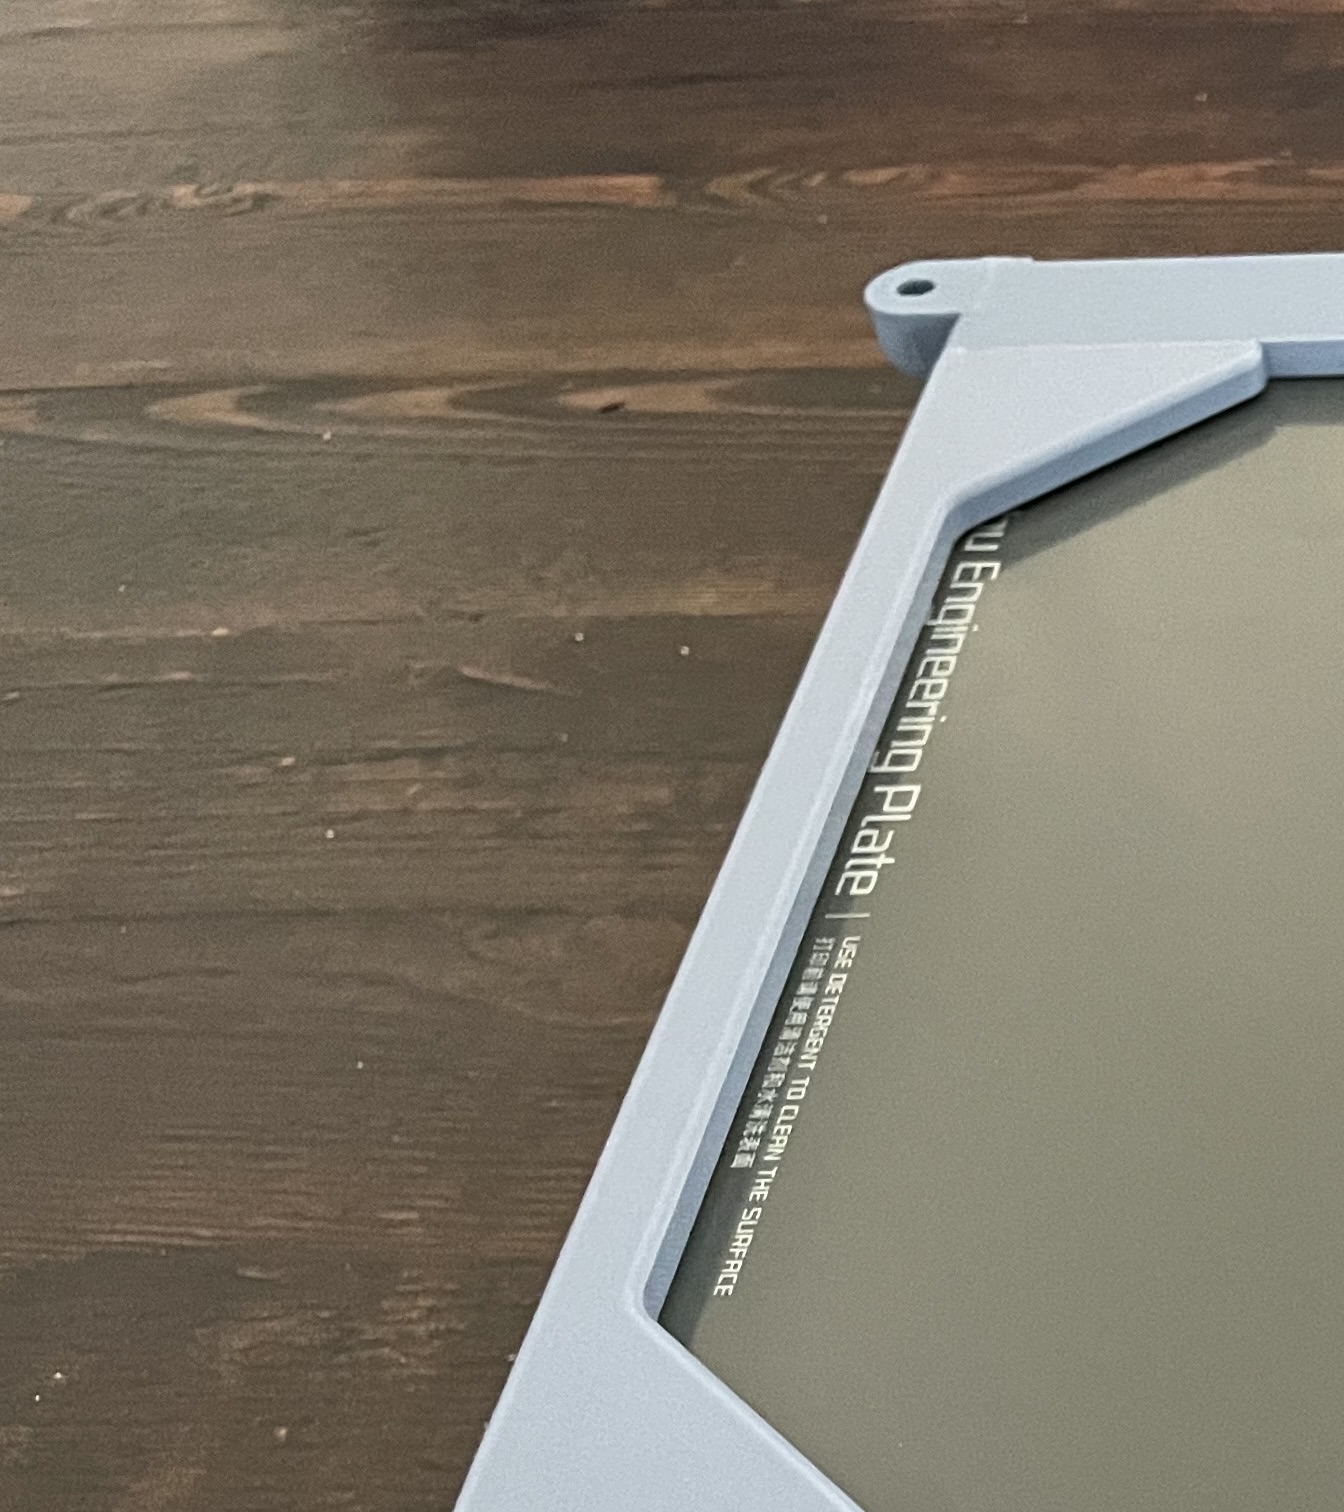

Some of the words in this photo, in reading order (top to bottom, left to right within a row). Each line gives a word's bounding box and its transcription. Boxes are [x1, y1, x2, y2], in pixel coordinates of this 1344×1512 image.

[866, 560, 1001, 774] Engineering
[834, 784, 921, 895] Plate
[834, 936, 861, 968] USE
[798, 973, 847, 1069] DETERGENT
[787, 1076, 810, 1100] TO
[764, 1104, 800, 1160] CLEAN
[749, 1167, 777, 1201] THE
[713, 1207, 762, 1296] SURFACE
